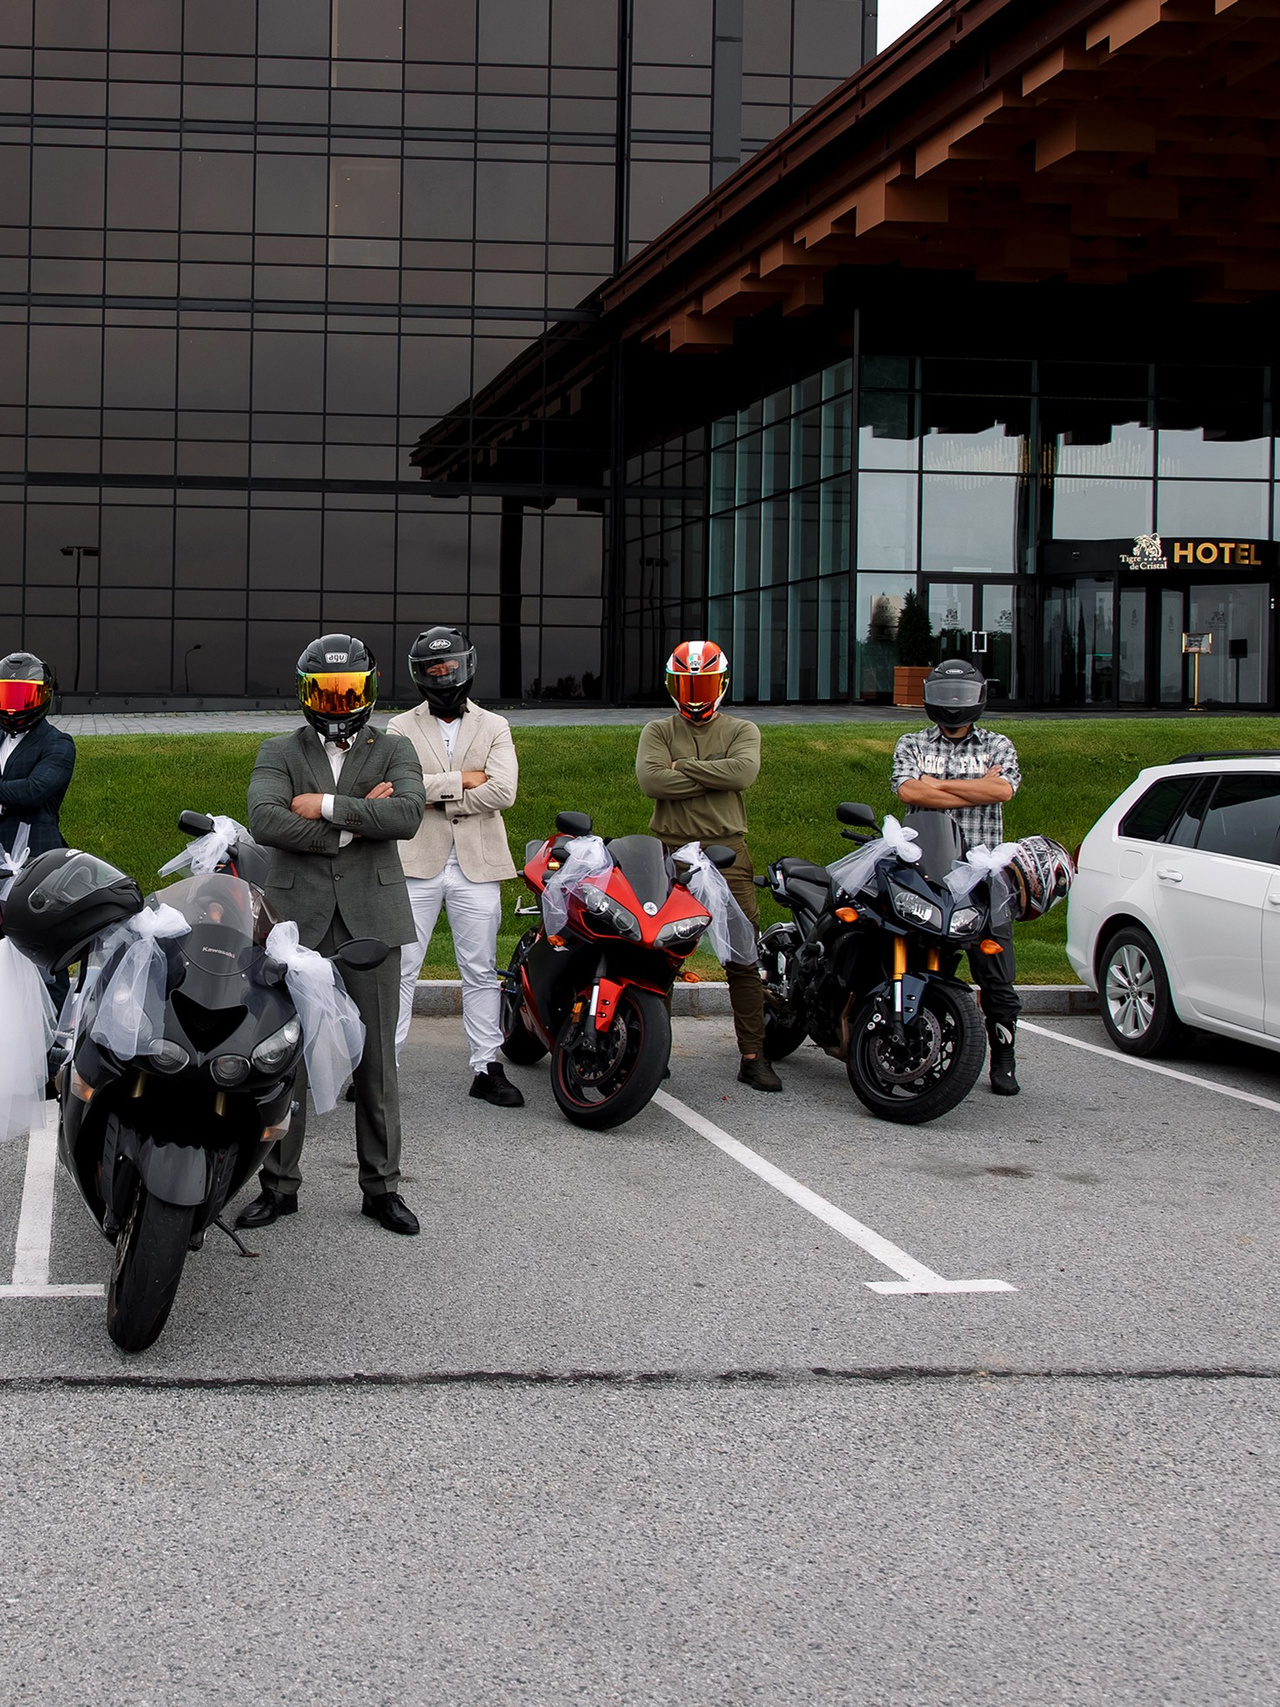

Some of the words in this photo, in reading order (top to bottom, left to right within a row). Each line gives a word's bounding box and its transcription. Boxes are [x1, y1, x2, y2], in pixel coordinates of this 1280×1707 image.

[1120, 554, 1141, 564] Tigre
[1173, 542, 1261, 565] HOTEL
[1140, 561, 1167, 570] Cristal
[202, 946, 236, 959] Kawasaki
